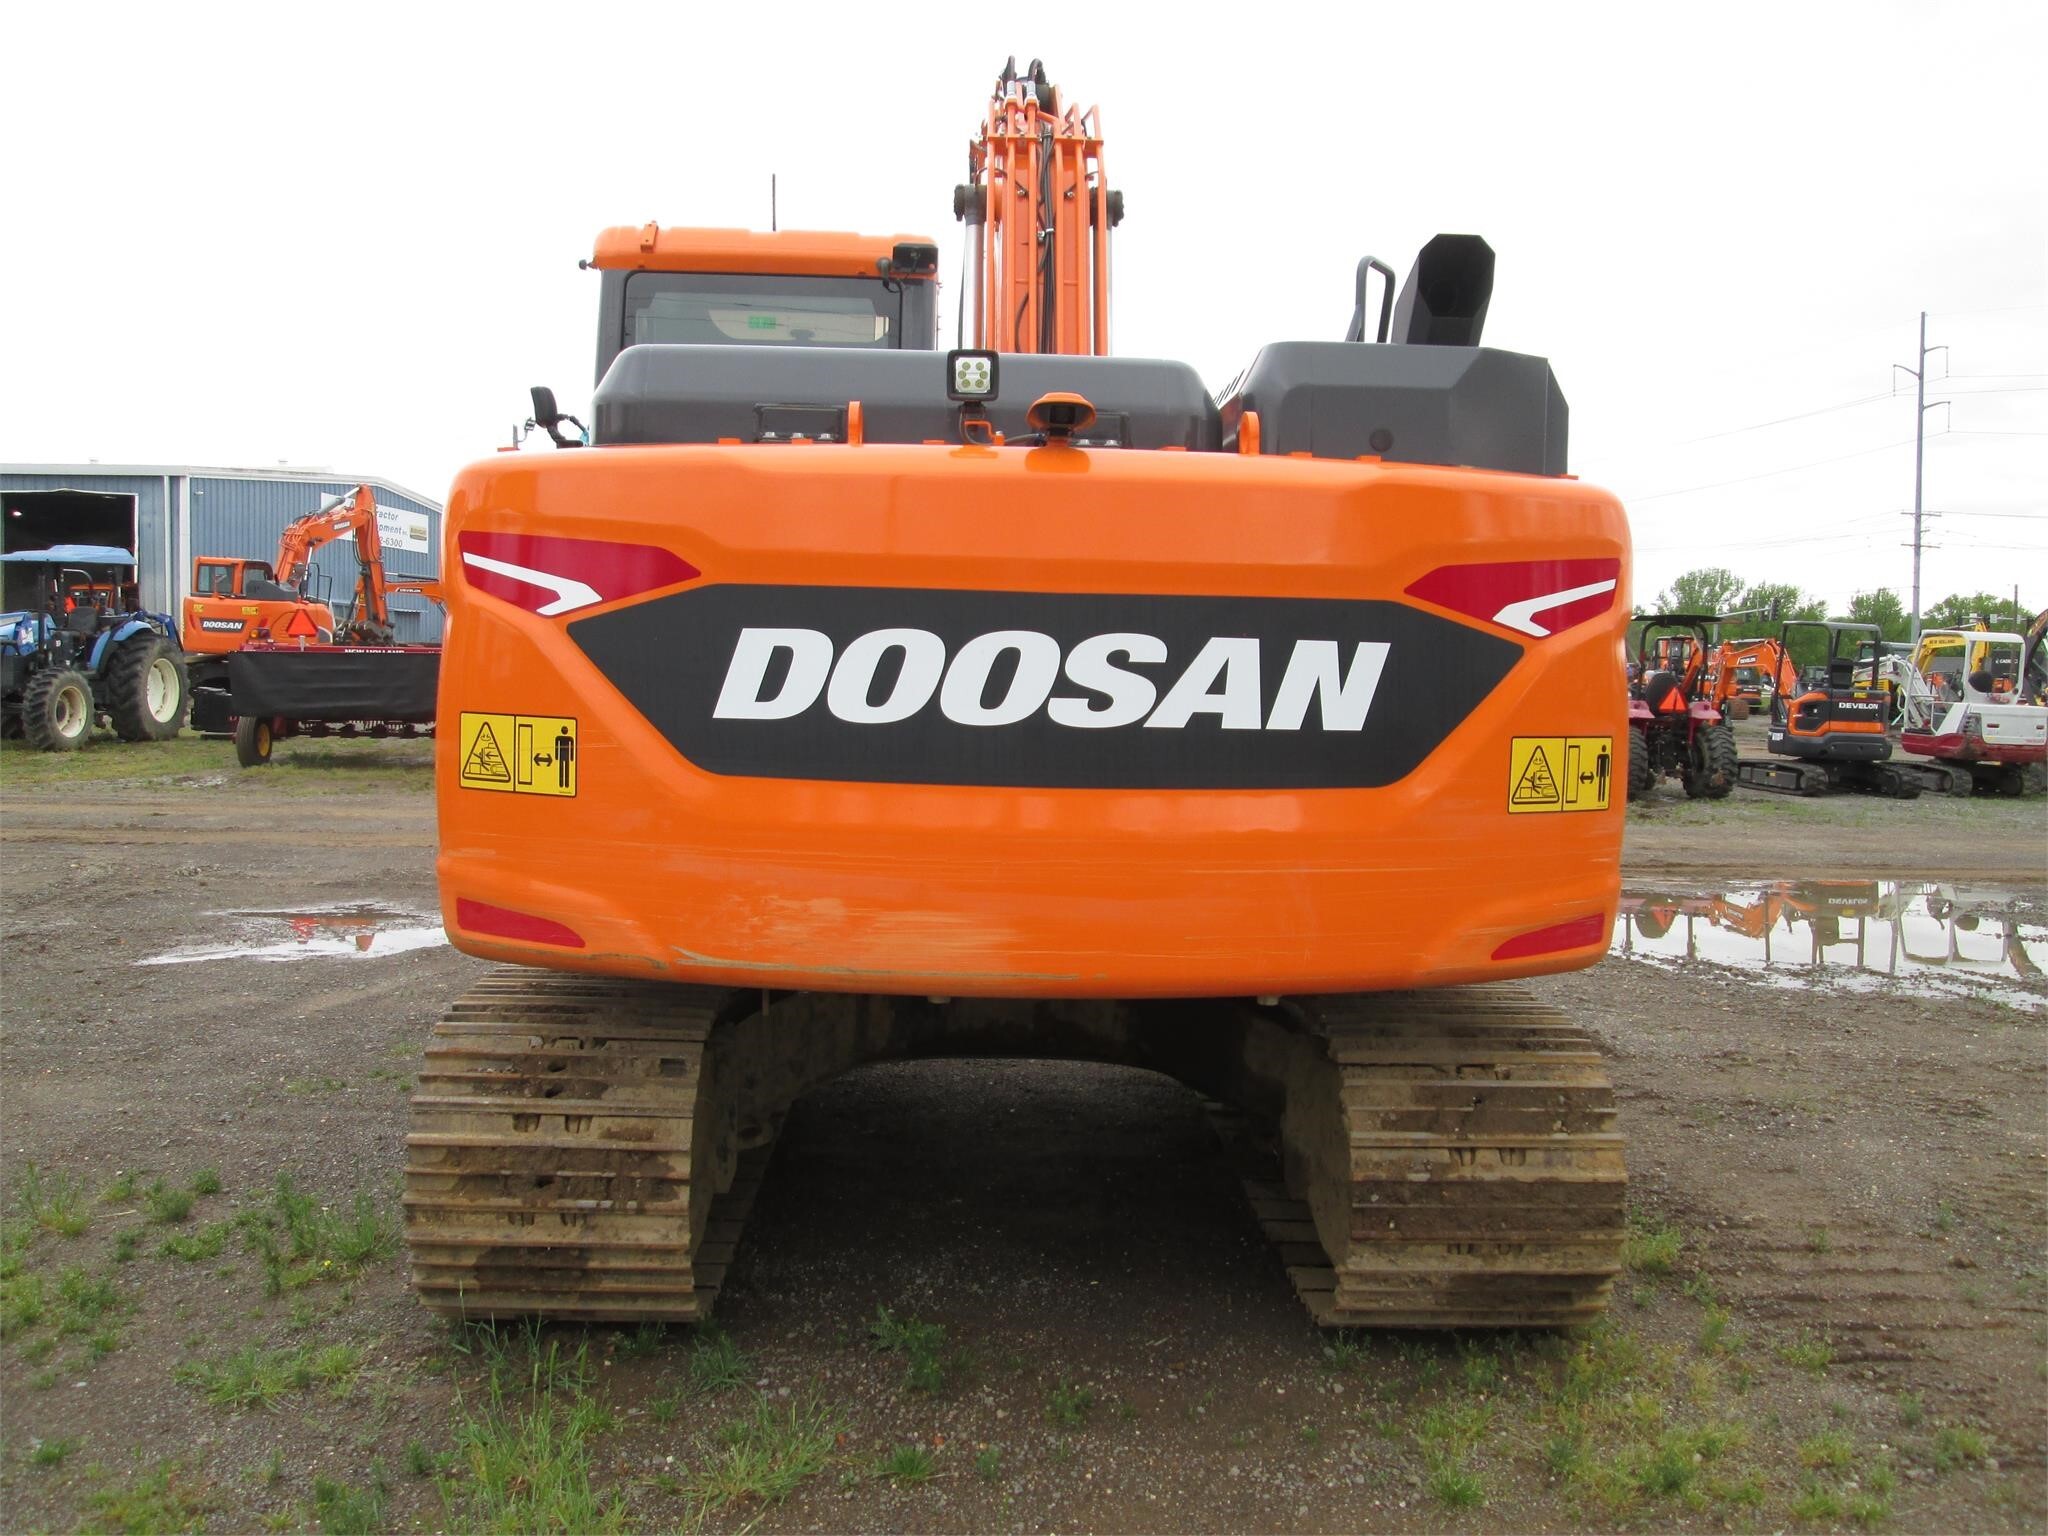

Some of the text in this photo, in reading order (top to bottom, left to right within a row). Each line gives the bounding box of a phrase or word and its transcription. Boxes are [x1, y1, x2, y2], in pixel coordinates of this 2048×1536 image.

[202, 621, 243, 630] DOOSAN
[713, 628, 1391, 730] DOOSAN
[1838, 701, 1878, 710] DEVELON
